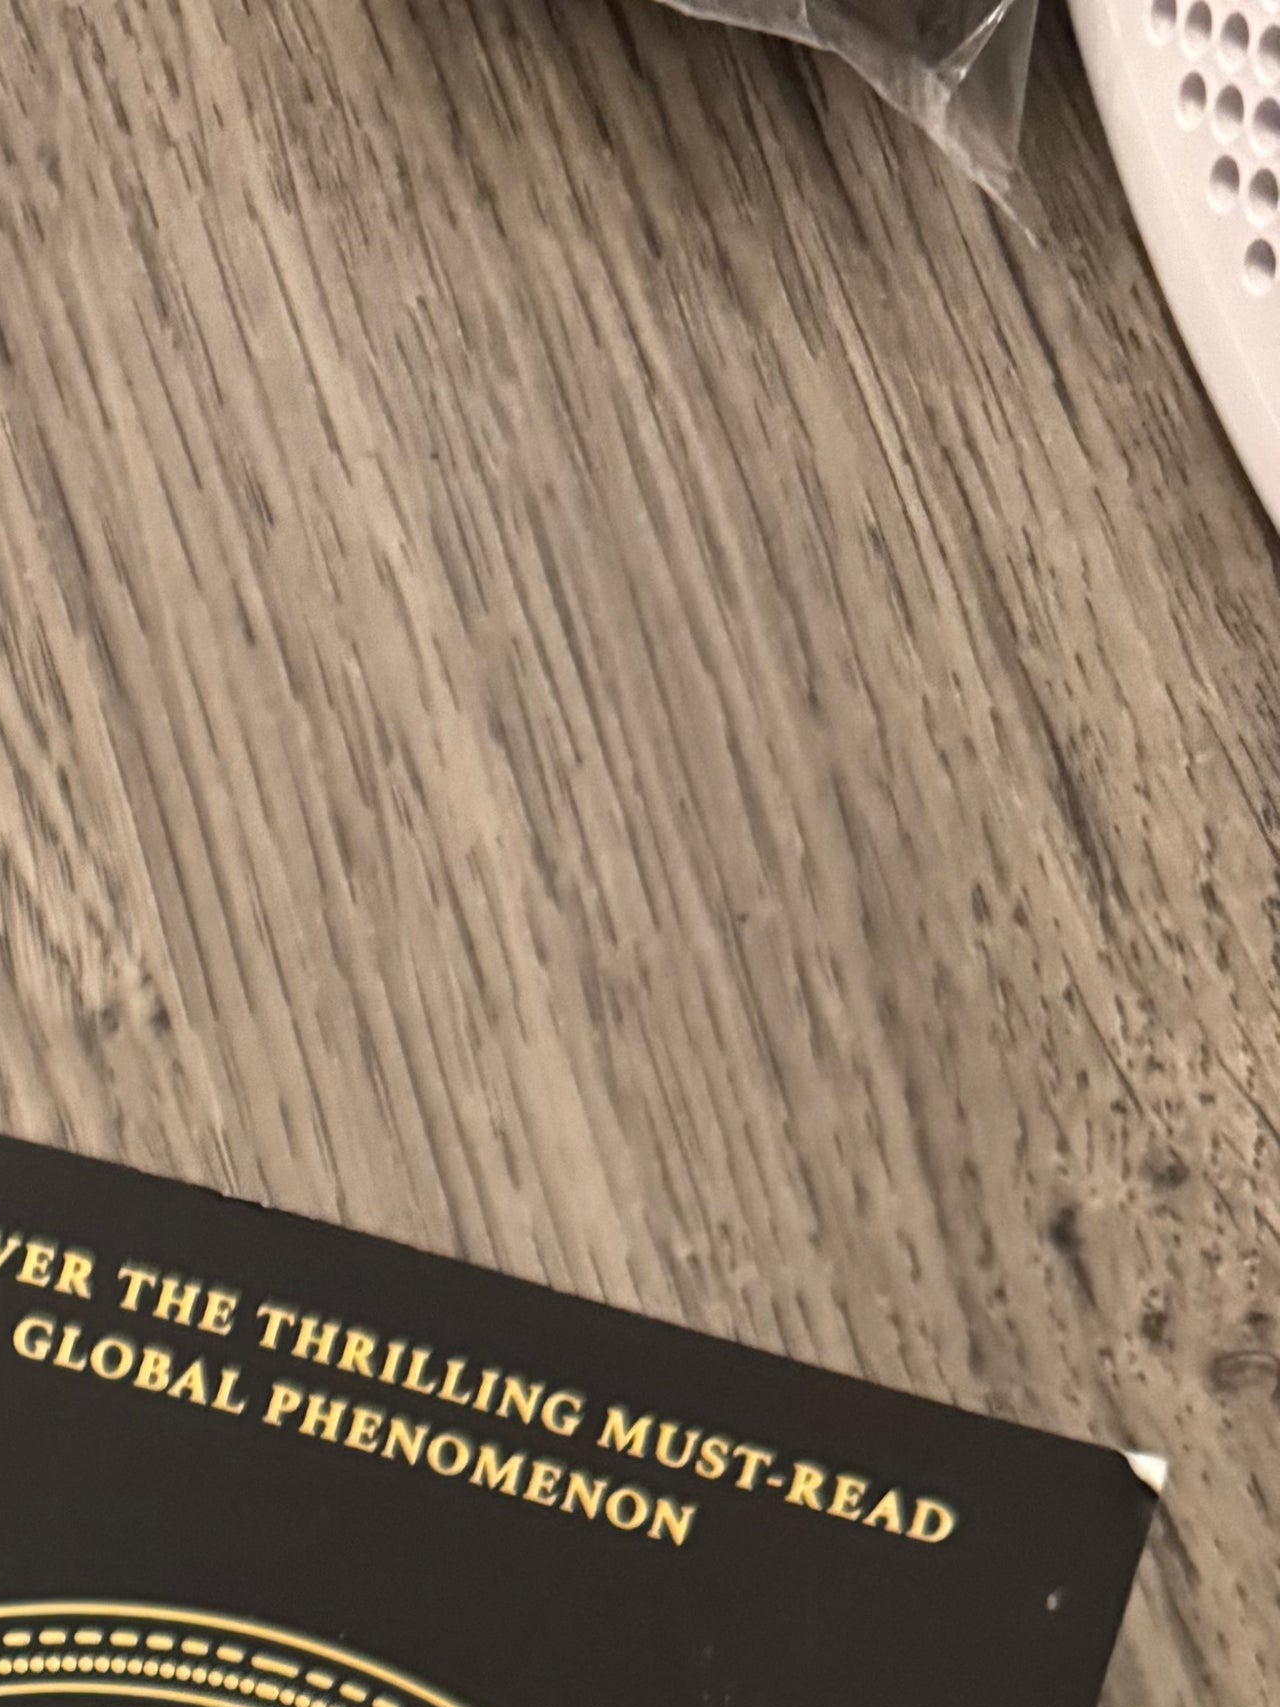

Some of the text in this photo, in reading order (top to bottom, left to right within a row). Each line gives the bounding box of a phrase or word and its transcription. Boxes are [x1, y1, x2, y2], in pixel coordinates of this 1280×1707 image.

[11, 1315, 694, 1547] GLOBAL PHENOMENON
[116, 1264, 238, 1337] THE
[256, 1300, 584, 1438] THRILLING
[598, 1406, 957, 1545] MUST-READ
